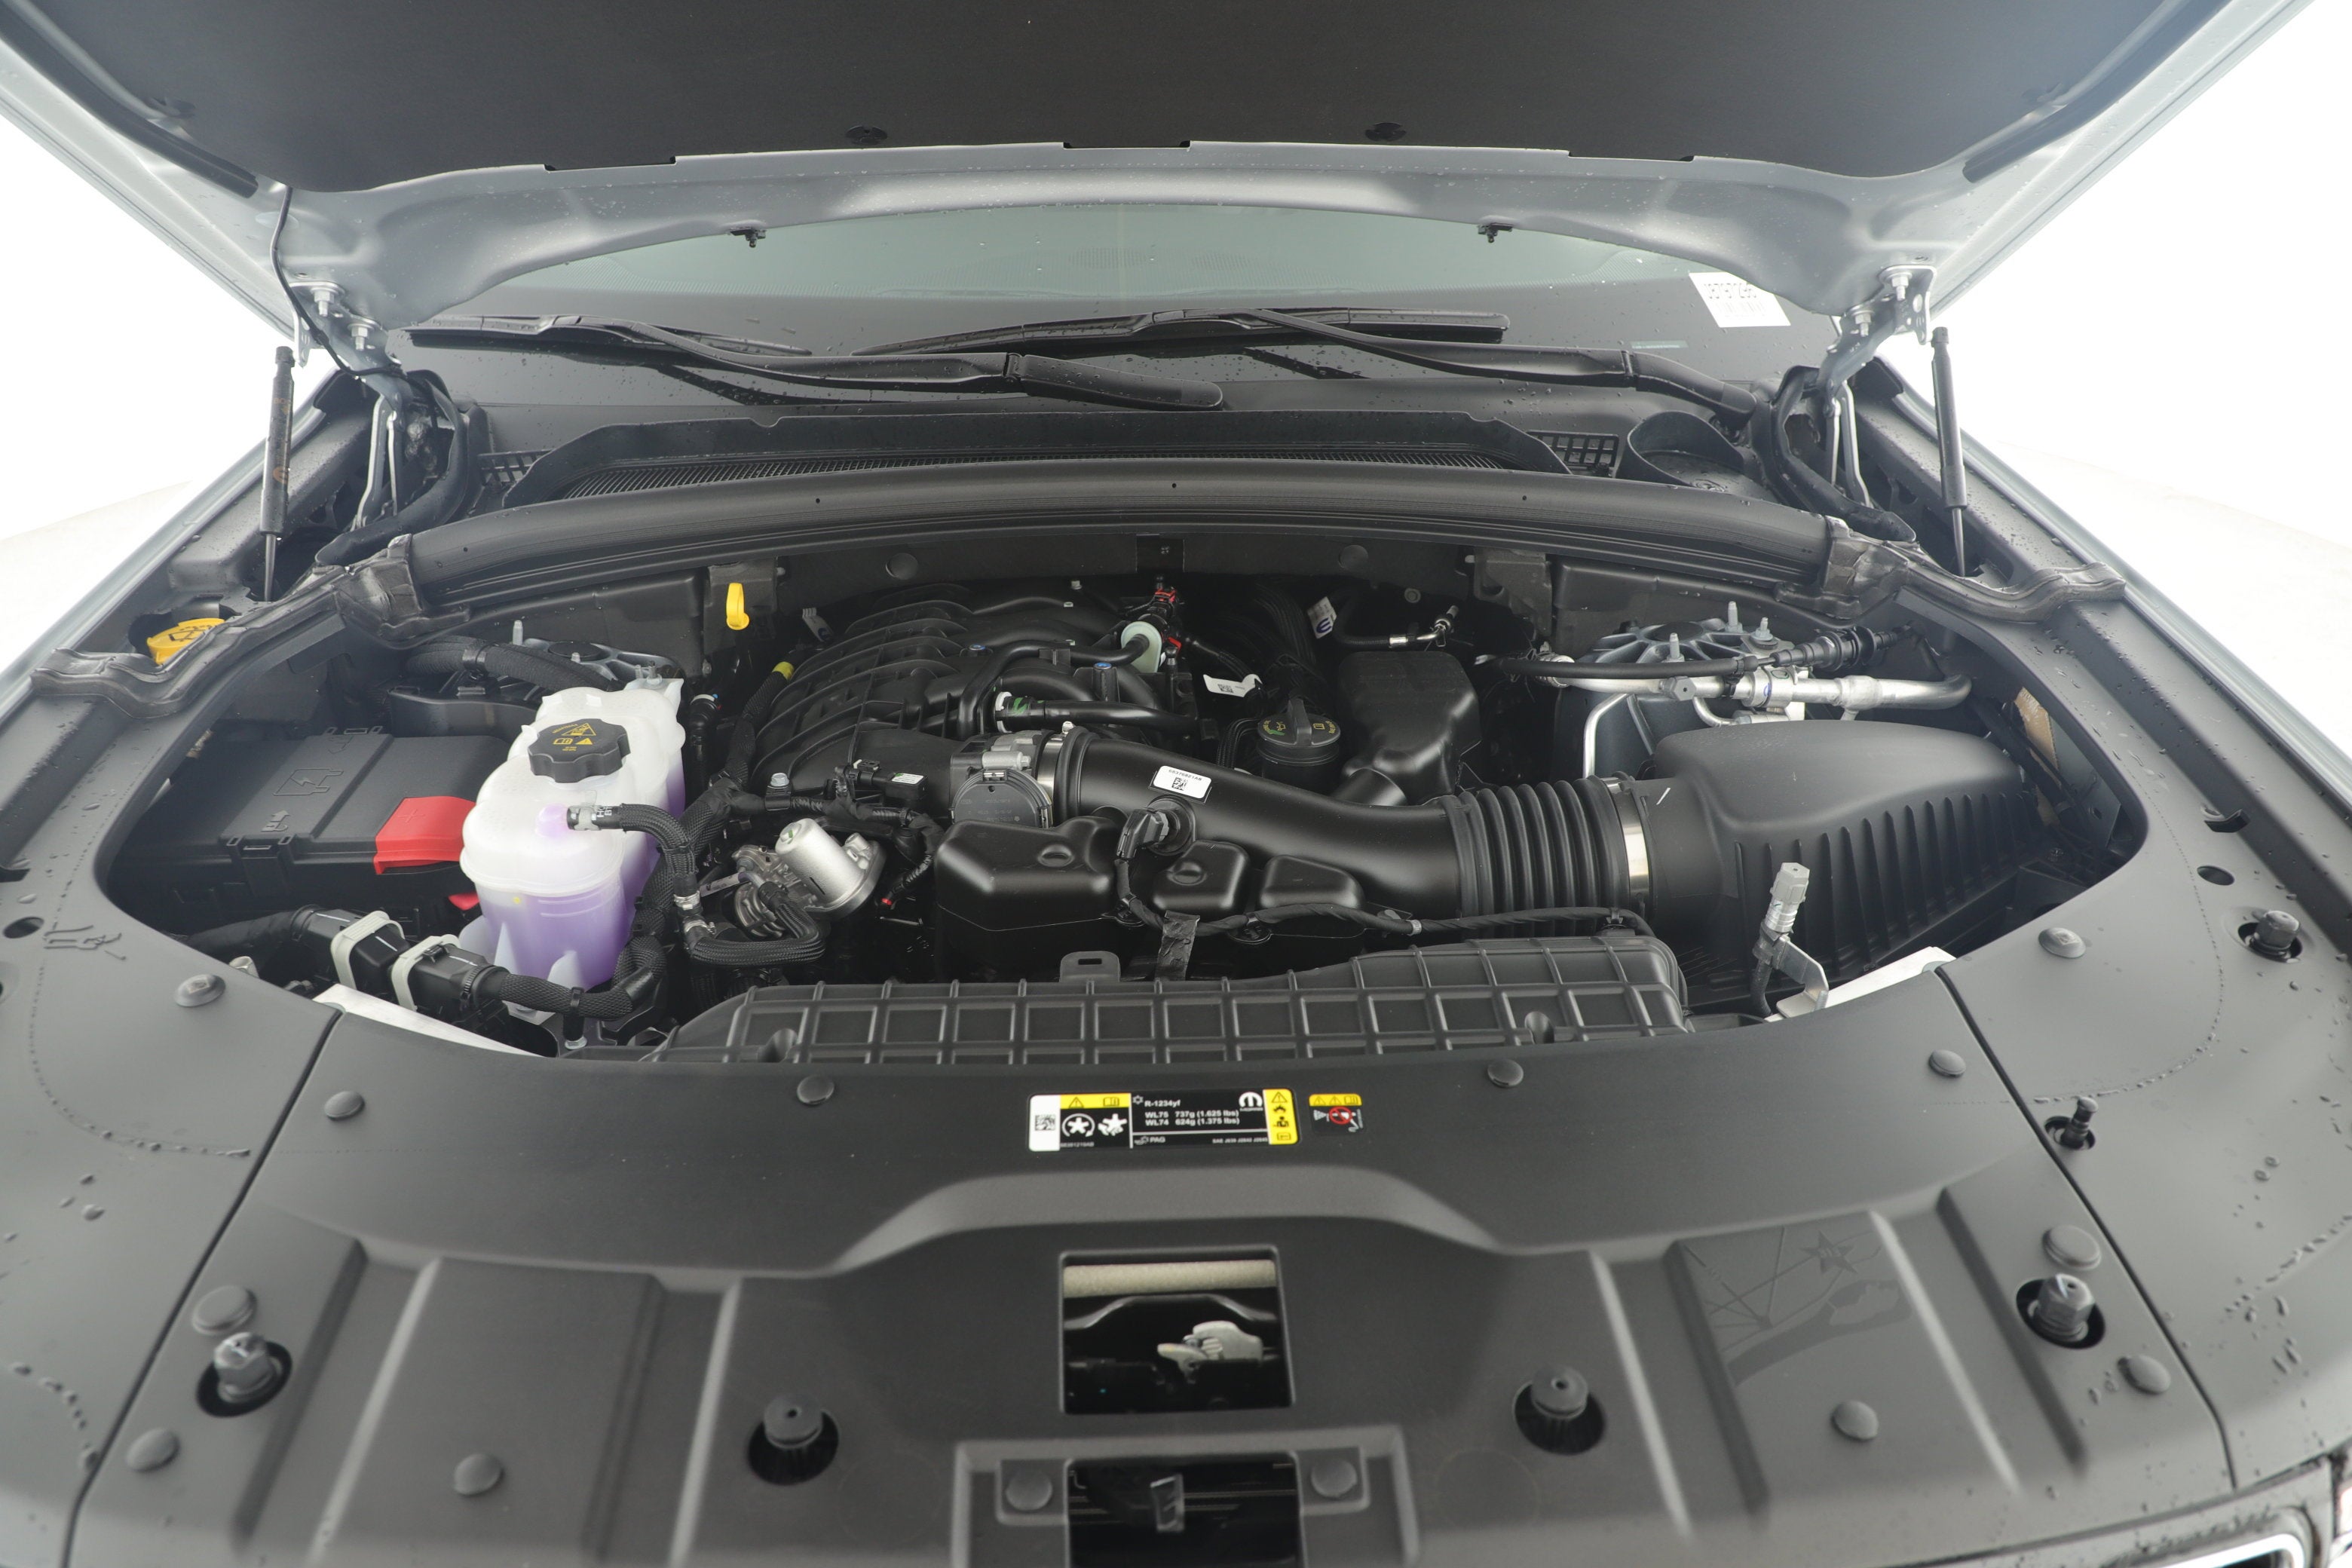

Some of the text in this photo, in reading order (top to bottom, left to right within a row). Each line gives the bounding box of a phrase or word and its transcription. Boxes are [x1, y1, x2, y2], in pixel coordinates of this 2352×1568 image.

[1144, 1099, 1181, 1108] R-1234yf
[1174, 1110, 1196, 1119] 737g
[1196, 1110, 1222, 1119] (1.625
[1223, 1110, 1239, 1118] lbs)
